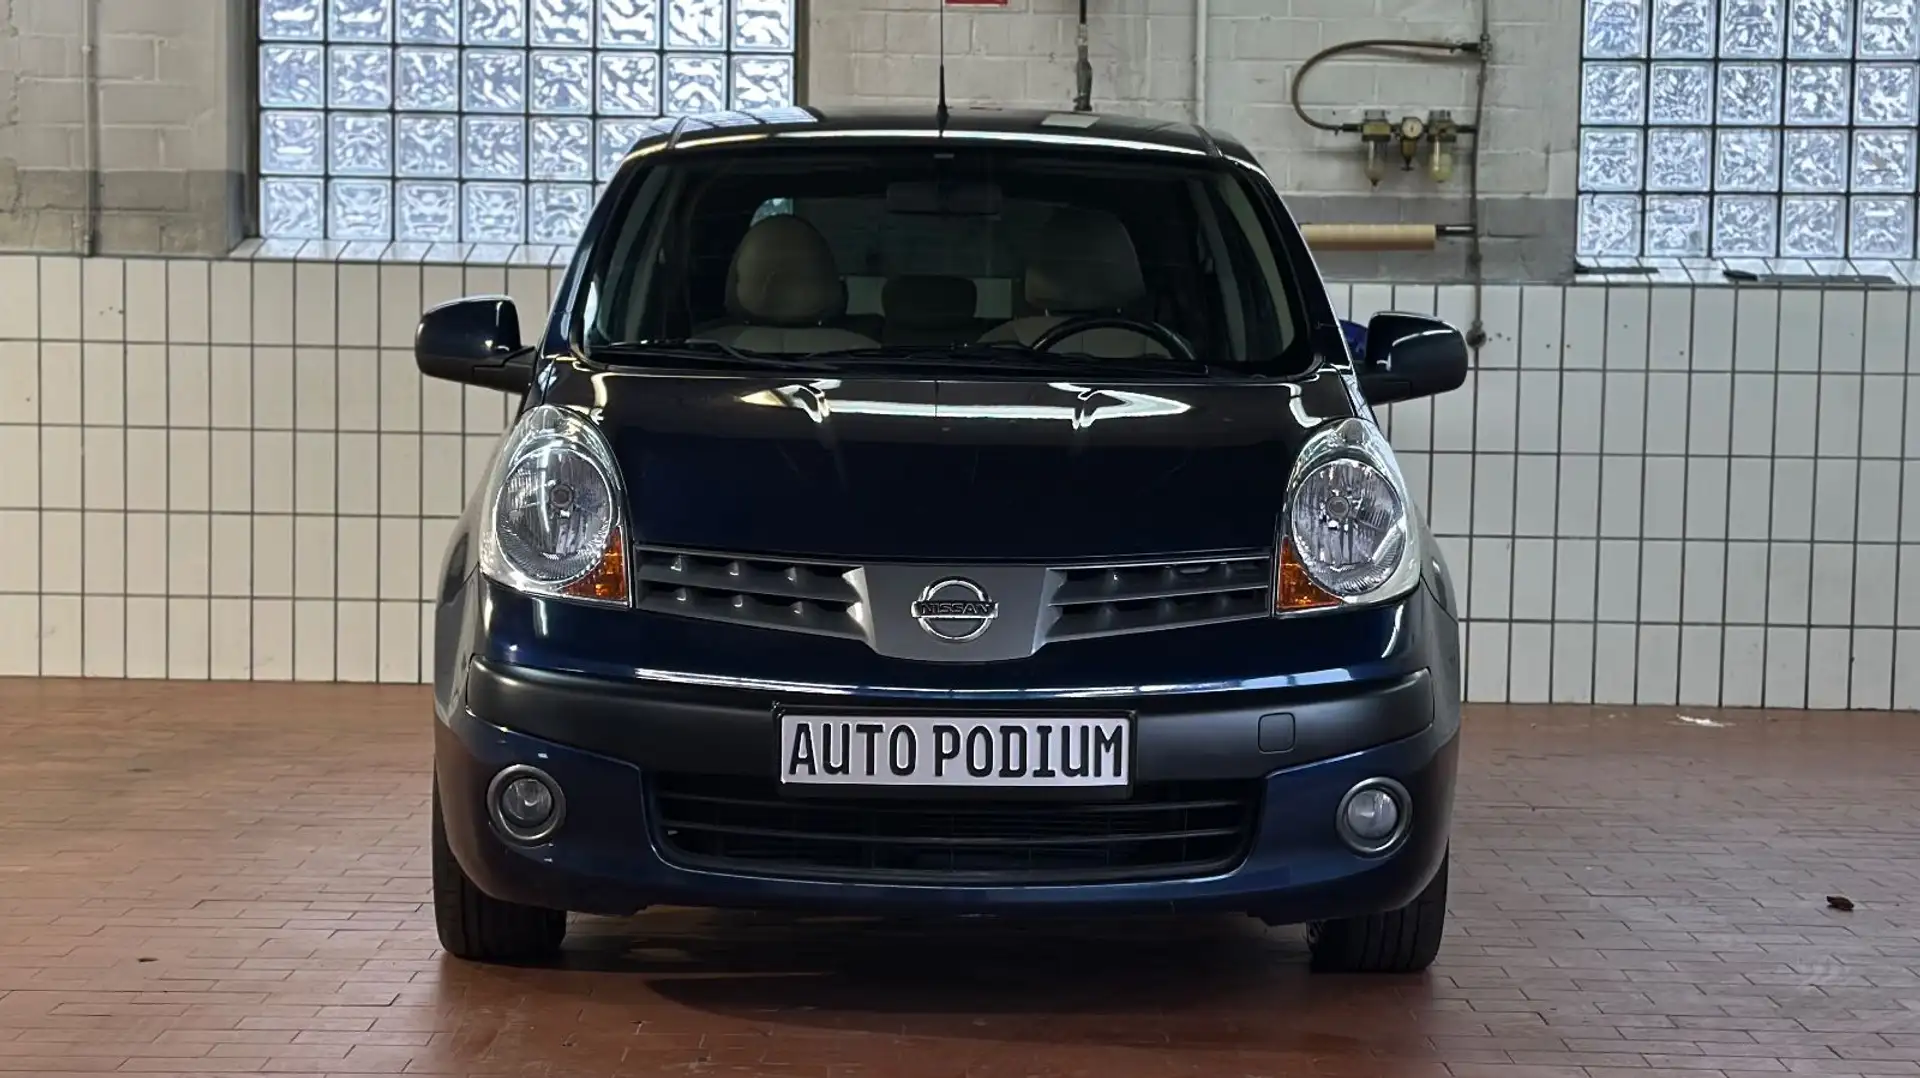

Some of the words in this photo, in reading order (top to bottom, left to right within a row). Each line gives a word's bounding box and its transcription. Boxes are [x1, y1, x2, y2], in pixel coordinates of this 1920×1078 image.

[921, 602, 990, 615] NISSAN
[788, 723, 917, 776] AUTO
[932, 725, 1123, 778] PODIUM
